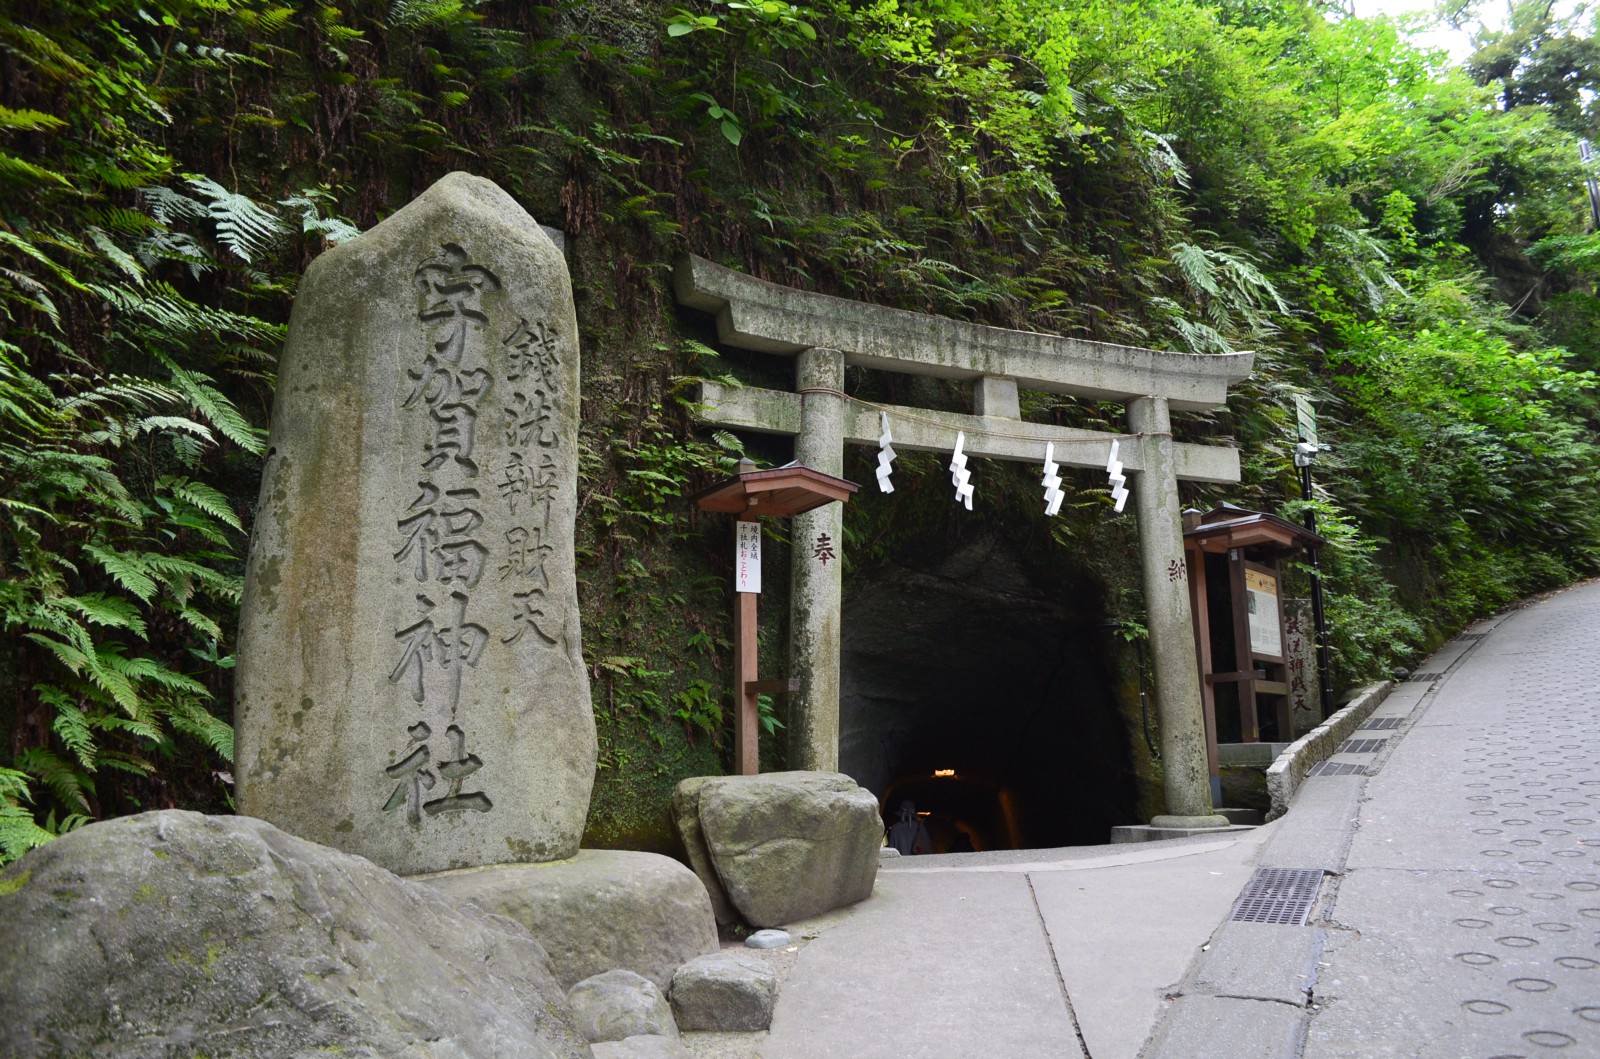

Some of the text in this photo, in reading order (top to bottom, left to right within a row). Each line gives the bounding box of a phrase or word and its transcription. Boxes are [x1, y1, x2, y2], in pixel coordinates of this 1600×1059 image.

[382, 242, 502, 828] 宇賀福神社
[740, 524, 748, 588] 千社札おことわり
[750, 525, 759, 561] 境内全域
[812, 532, 836, 567] 奉
